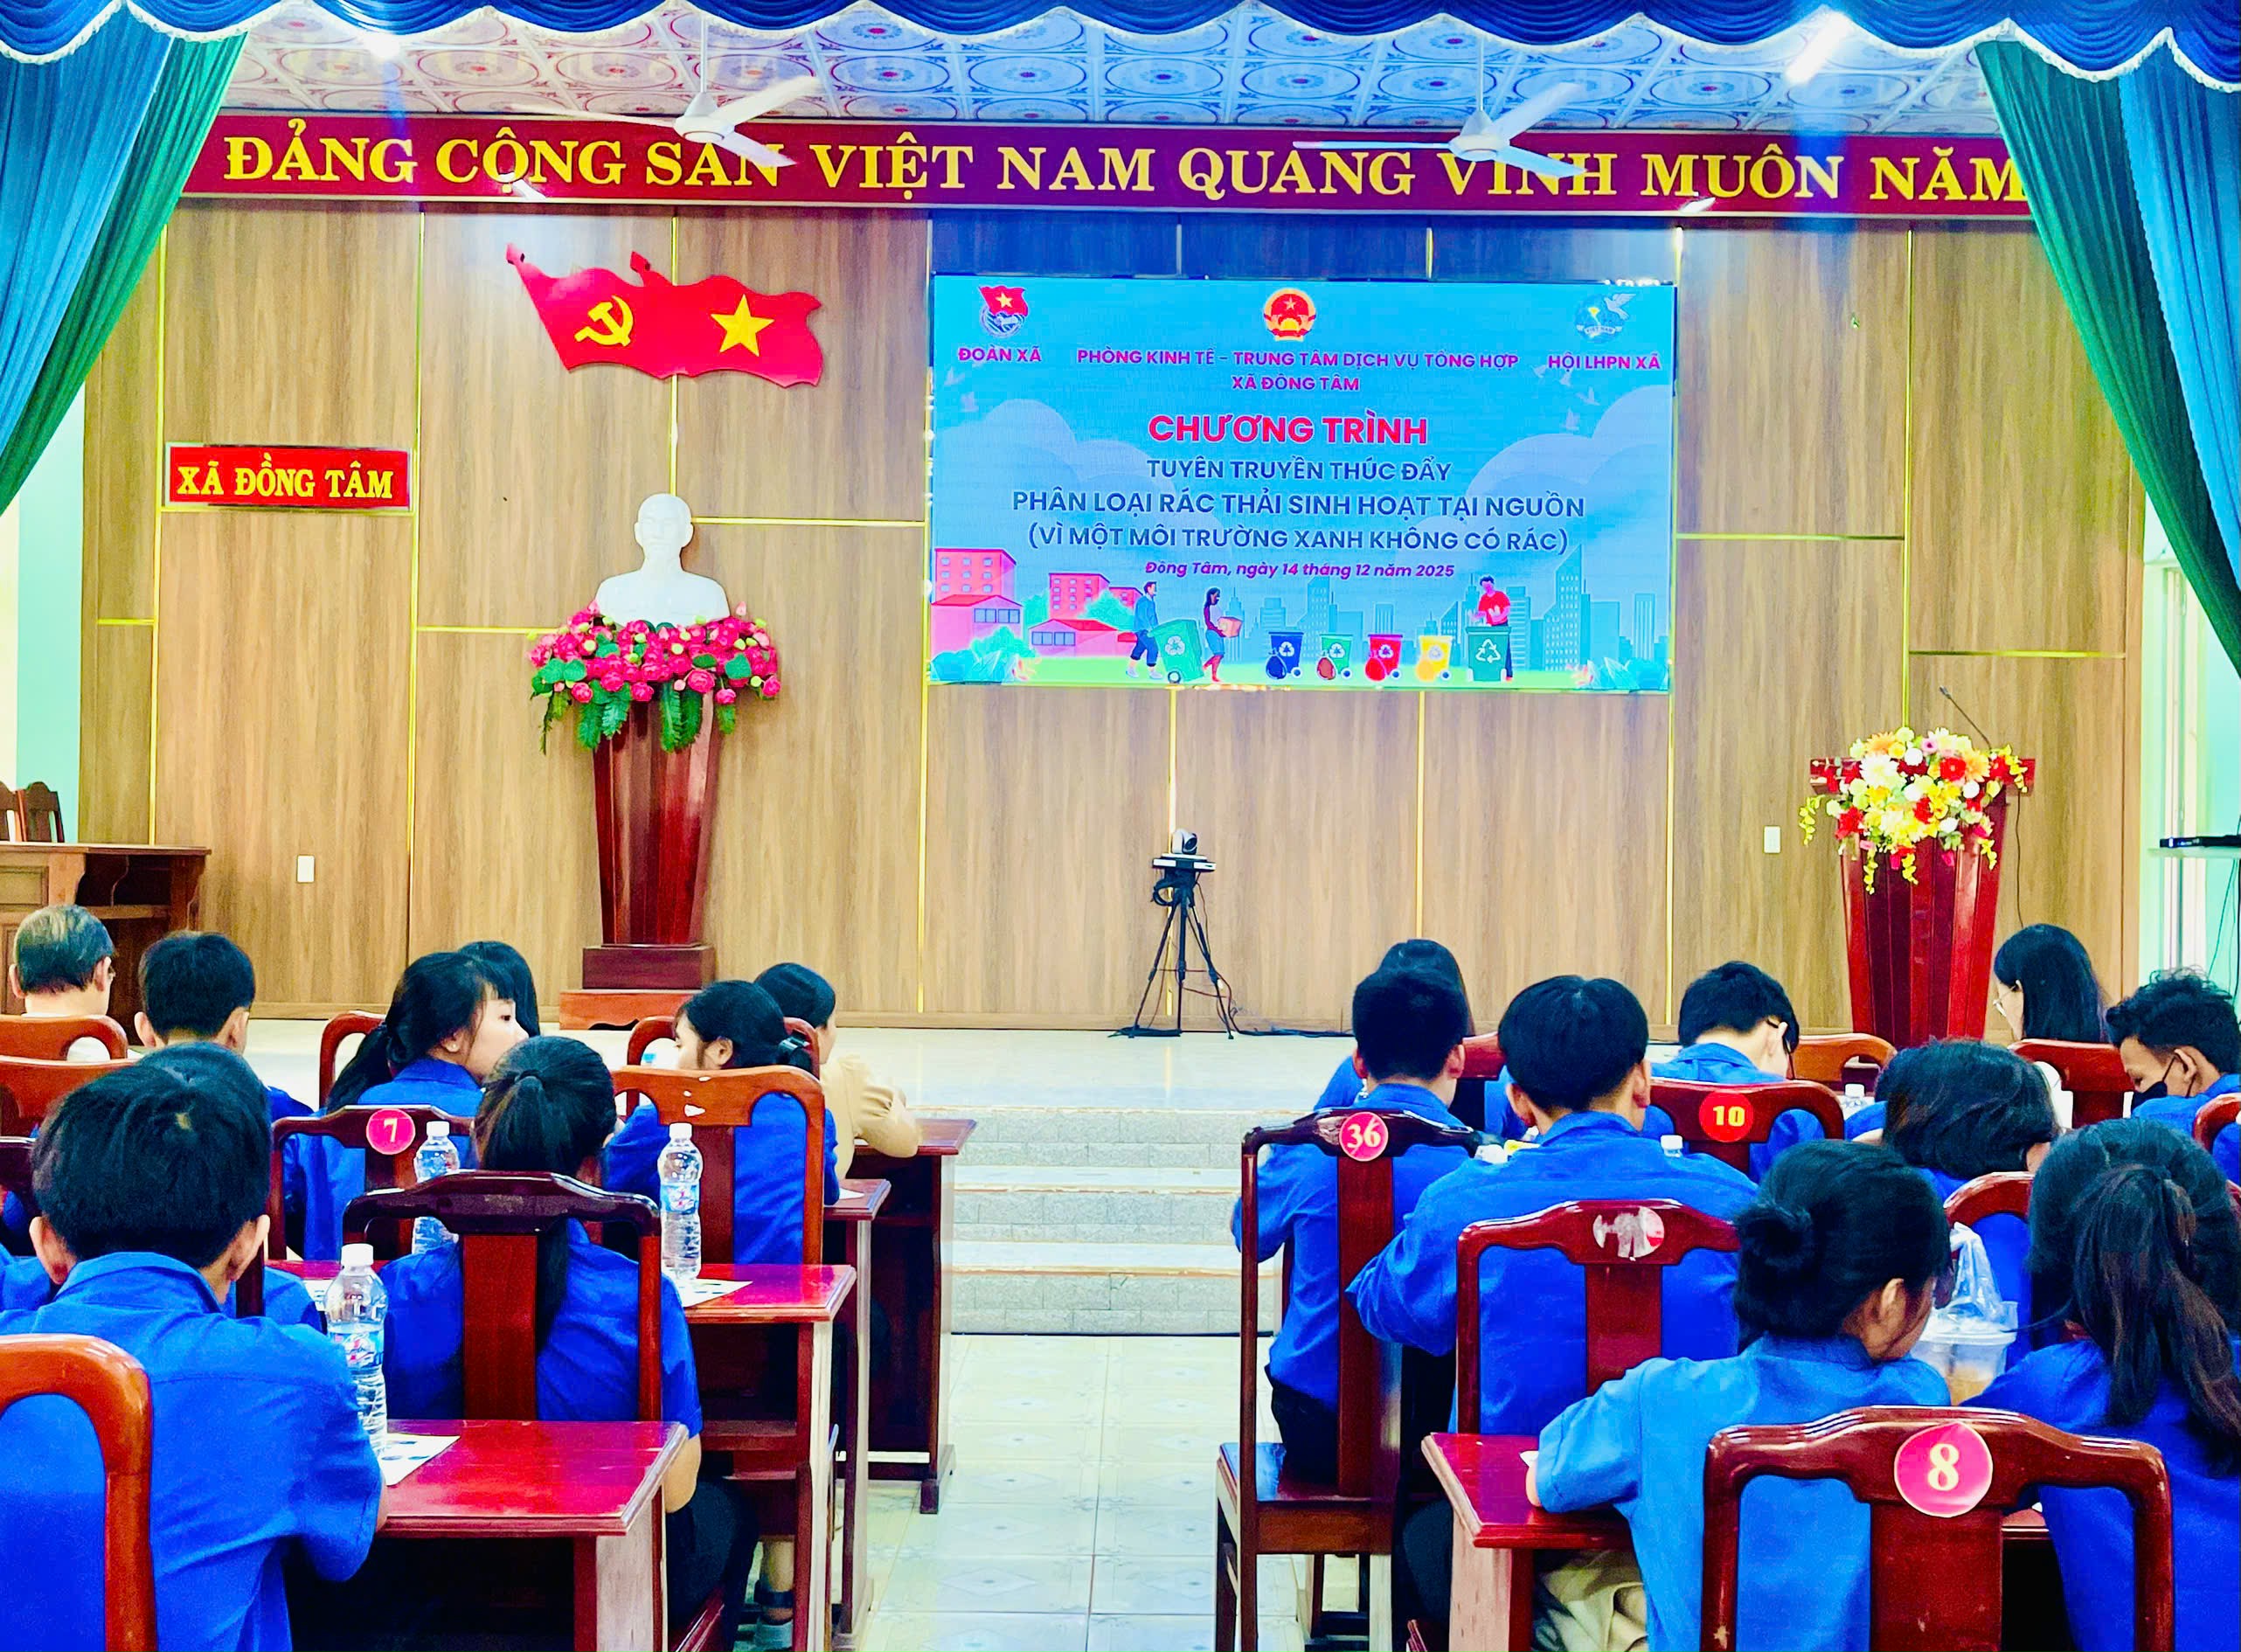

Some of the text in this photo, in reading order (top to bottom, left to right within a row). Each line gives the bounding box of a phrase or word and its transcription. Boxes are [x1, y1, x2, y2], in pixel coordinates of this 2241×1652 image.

[224, 118, 418, 182] ĐẢNG
[435, 127, 627, 192] CỘNG
[809, 131, 974, 201] VIỆT
[996, 147, 1155, 192] NAM
[1177, 147, 1415, 201] QUANG
[1641, 147, 1840, 200] MUÔN
[1870, 146, 2029, 202] NĂM
[958, 344, 1042, 362] ĐOÀN XÃ
[1077, 345, 1142, 364] PHÒNG
[1147, 351, 1190, 365] KINH
[1232, 351, 1295, 366] TRUNG
[1299, 350, 1338, 366] TÂM
[1343, 353, 1389, 370] DỊCH
[1394, 354, 1419, 371] VỤ
[1480, 354, 1519, 371] HỢP
[1548, 352, 1661, 372] HỘI LHPN XÃ
[1232, 372, 1257, 390] XÃ
[1319, 374, 1360, 391] TÂM
[1148, 410, 1427, 444] CHƯƠNG TRÌNH
[177, 451, 393, 499] XÃ ĐỒNG TÂM
[1147, 455, 1454, 482] TUYÊN TRUYỀN THÚC ĐẨY
[1013, 487, 1585, 522] PHÂN LOẠI RÁC THẢI SINH HOẠT TẠI NGUỒN
[1029, 522, 1568, 556] (VÌ MỘT MÔI TRƯỜNG XANH KHÔNG CÓ RÁC)
[1192, 561, 1232, 577] Tâm,
[1236, 562, 1279, 580] ngày
[1282, 564, 1299, 575] 14
[1302, 563, 1351, 580] tháng
[1356, 565, 1370, 576] 12
[1374, 564, 1412, 577] năm
[1415, 565, 1455, 577] 2025
[383, 1118, 398, 1143] 7
[1712, 1106, 1746, 1128] 10
[1346, 1115, 1382, 1150] 36
[1927, 1443, 1960, 1492] 8
